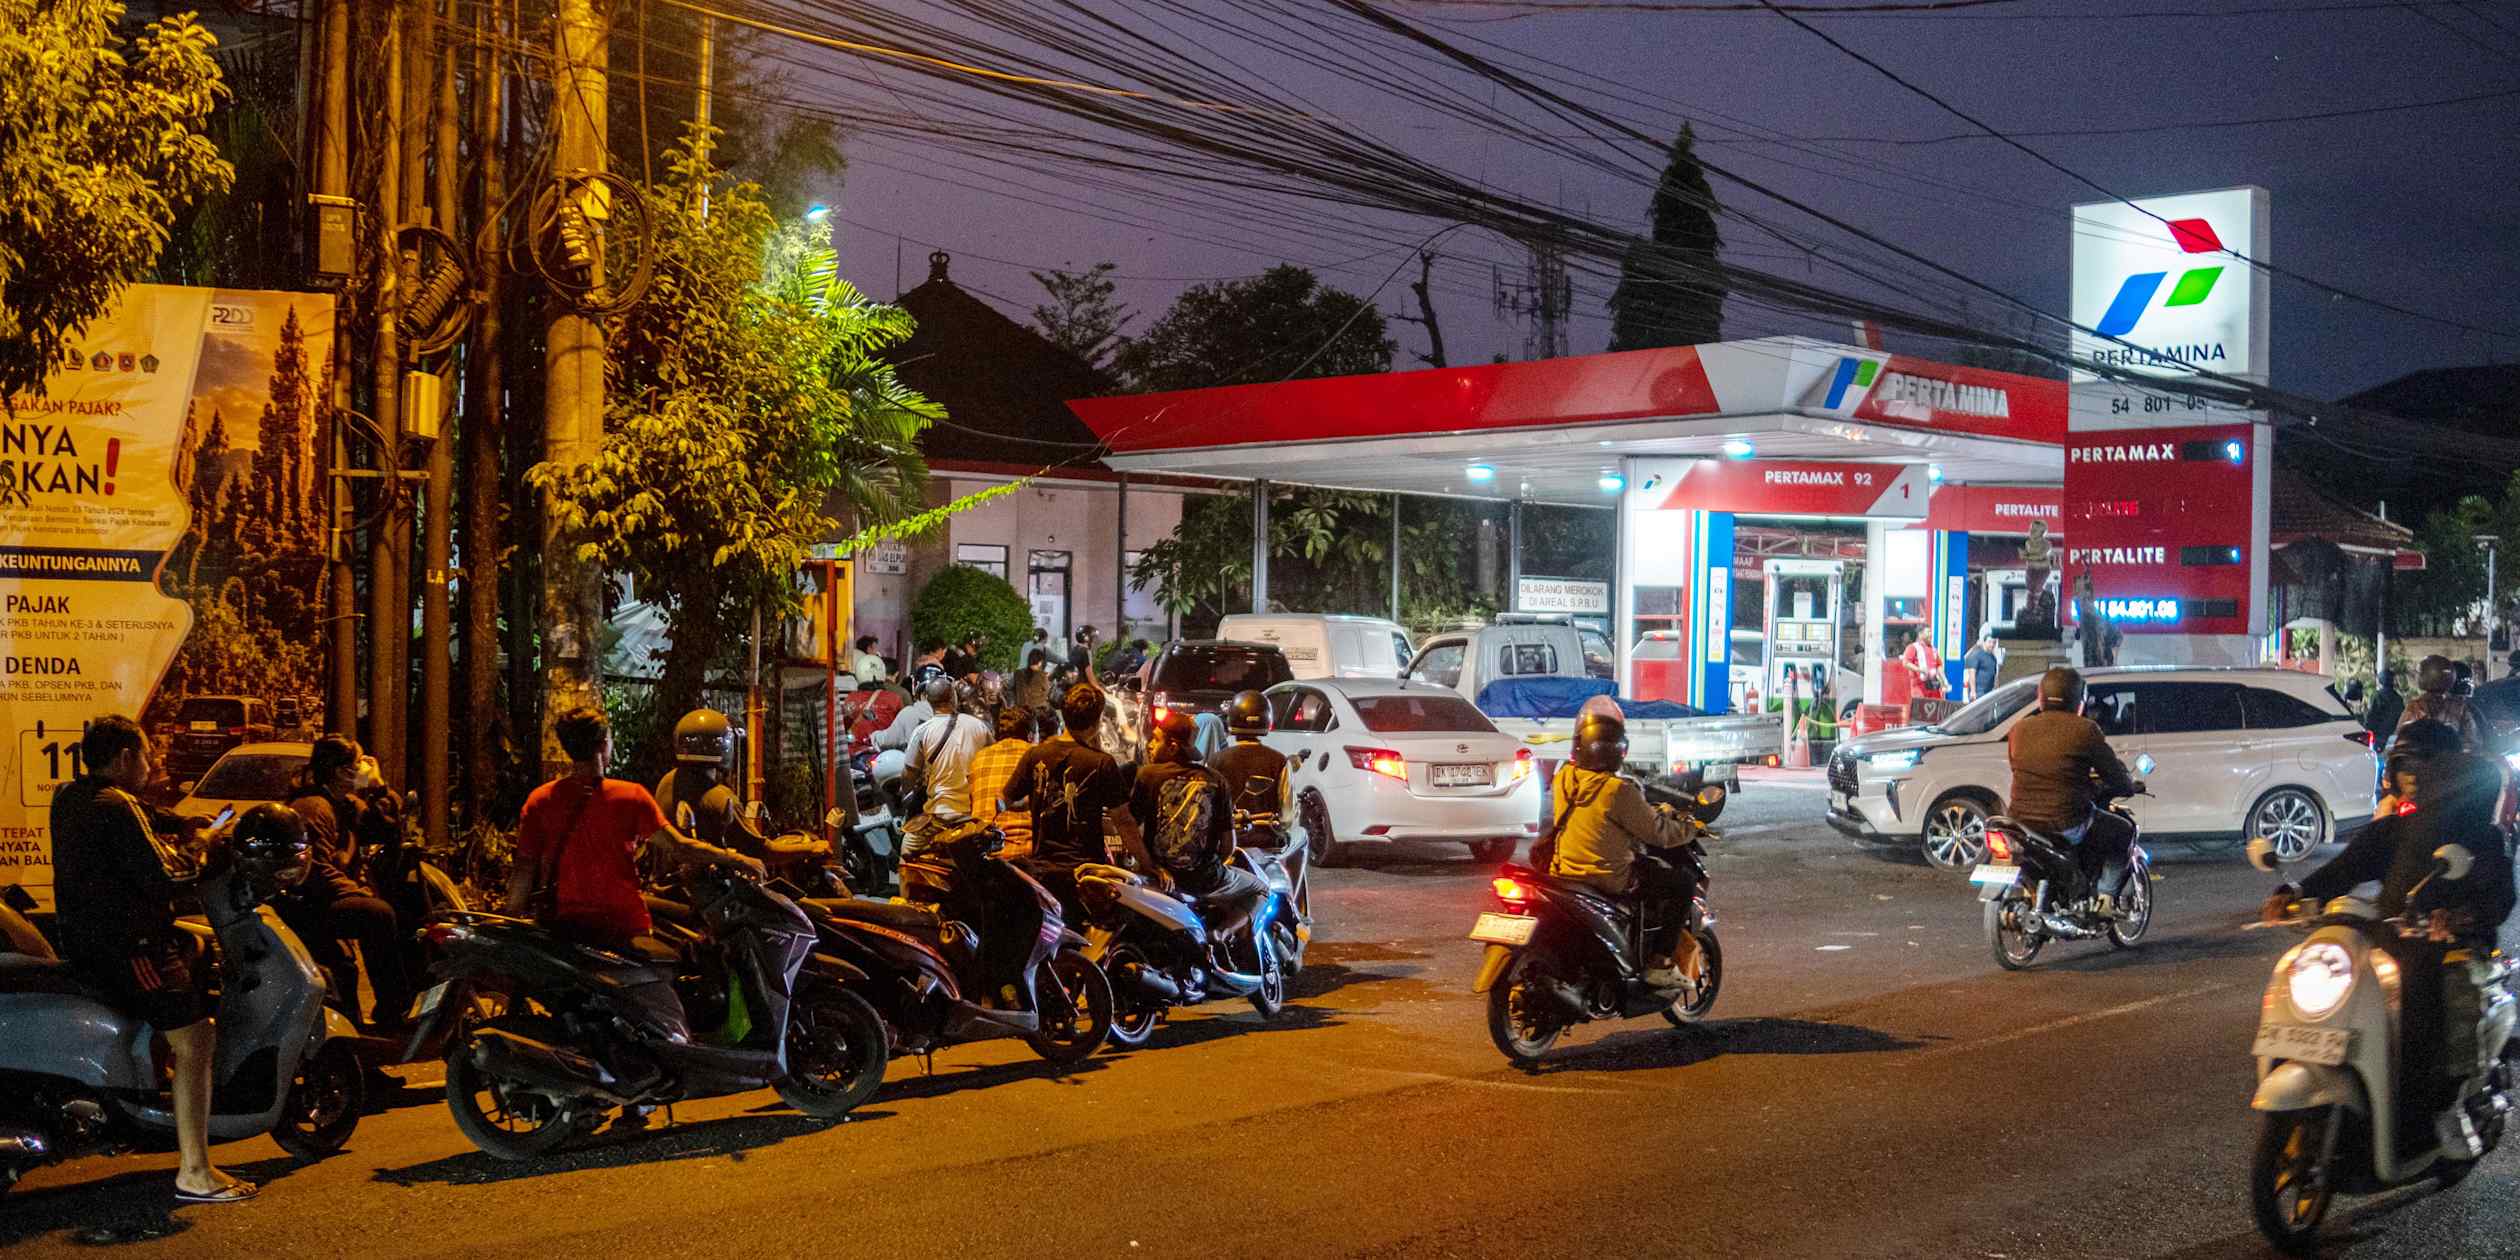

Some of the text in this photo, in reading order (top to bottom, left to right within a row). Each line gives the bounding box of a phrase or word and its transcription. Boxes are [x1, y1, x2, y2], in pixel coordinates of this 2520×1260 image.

[1884, 372, 2009, 418] PERTAMINA
[69, 400, 121, 416] PAJAK?
[2111, 397, 2130, 414] 54
[2144, 395, 2170, 412] 801
[3, 423, 77, 457] NYA
[2071, 443, 2175, 463] PERTAMAX
[1765, 470, 1872, 486] PERTAMAX 92
[1901, 483, 1910, 499] 1
[1995, 503, 2059, 518] PERTALITE
[0, 553, 141, 573] KEUNTUNGANNYA
[1521, 583, 1562, 594] DILARANG
[6, 595, 70, 614] PAJAK
[8, 618, 29, 627] PKB
[32, 618, 67, 628] TAHUN
[105, 620, 175, 631] SETERUSNYA
[11, 631, 32, 640] PKB
[35, 631, 71, 640] UNTUK
[84, 631, 118, 641] TAHUN
[5, 656, 81, 675] DENDA
[33, 681, 71, 690] OPSEN
[100, 682, 122, 691] DAN
[22, 692, 92, 703] SEBELUMNYA
[2, 827, 45, 839] TEPAT
